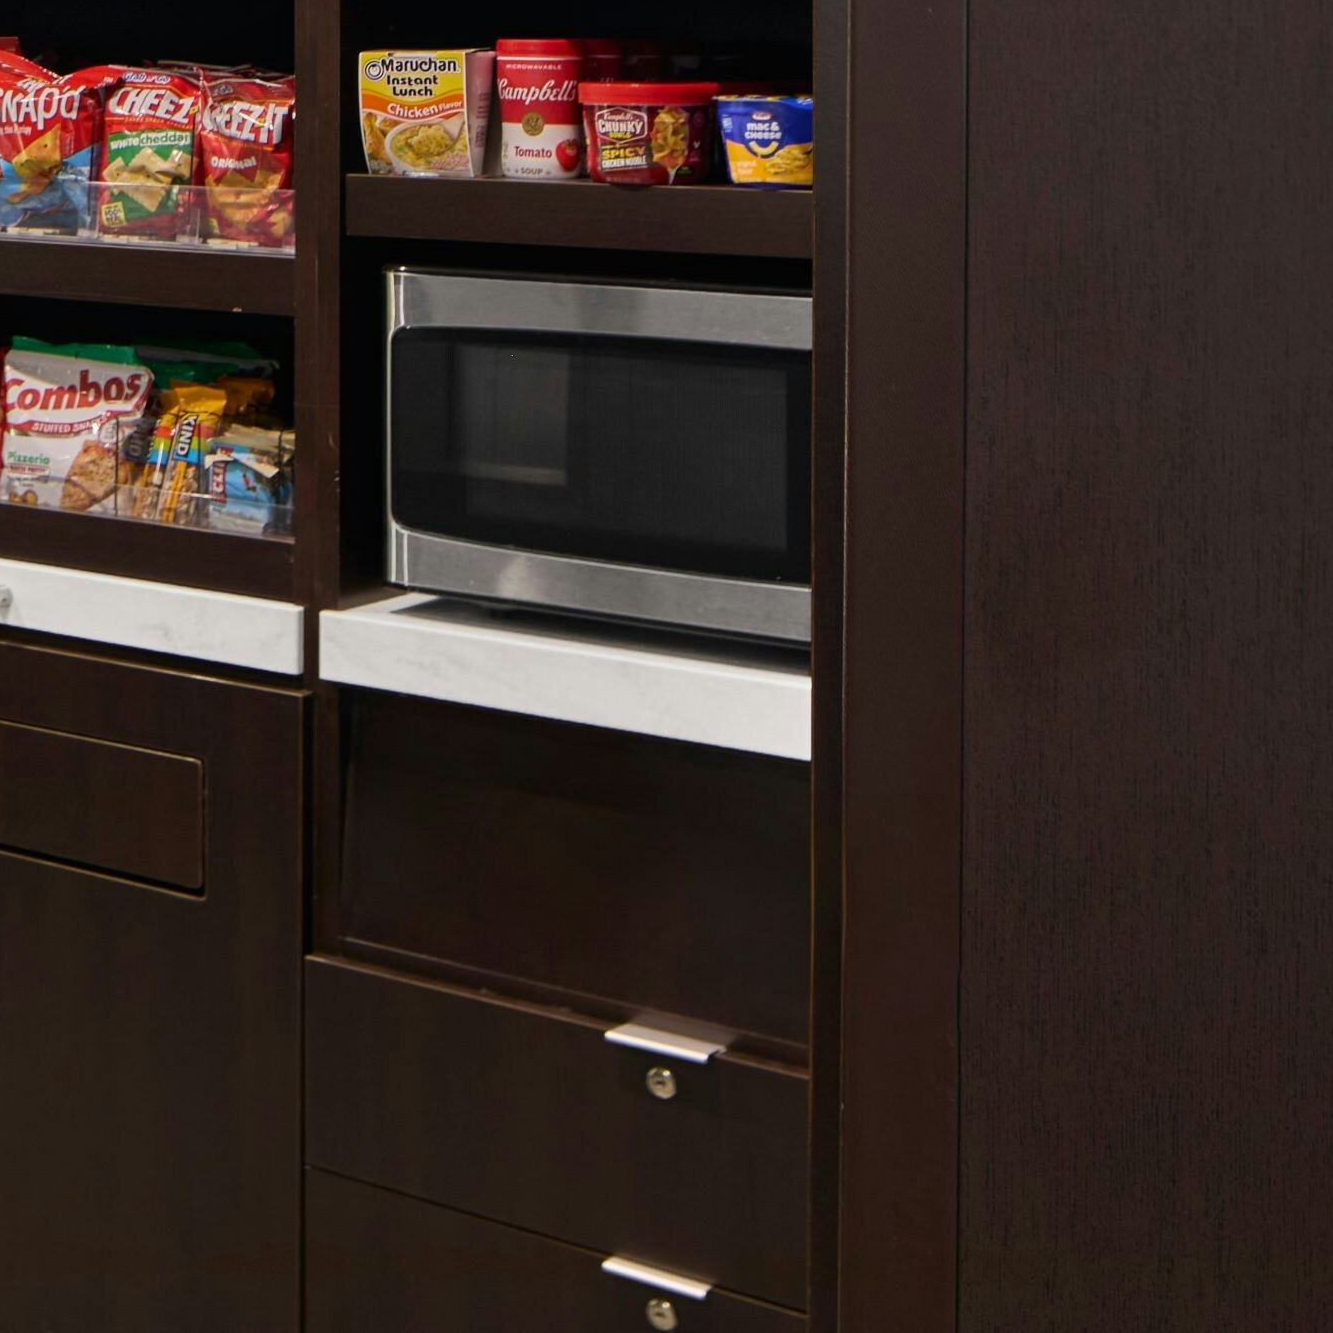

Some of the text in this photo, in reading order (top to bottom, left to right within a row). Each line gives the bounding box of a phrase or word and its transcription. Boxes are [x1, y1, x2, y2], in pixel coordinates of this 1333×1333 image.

[382, 56, 458, 73] Maruchan
[505, 62, 562, 70] MICROWAVABLE
[386, 74, 439, 87] Instant
[392, 85, 433, 97] Lunch
[498, 78, 578, 106] Campbell's
[387, 102, 440, 118] Chicken
[597, 118, 644, 135] CHUNKY
[514, 145, 552, 159] Tomato
[601, 146, 647, 160] SPICY
[520, 167, 543, 175] SOUP
[5, 369, 145, 413] Combos
[32, 422, 71, 433] STUFFED
[177, 415, 201, 457] KIND
[7, 451, 51, 465] Pizzeria
